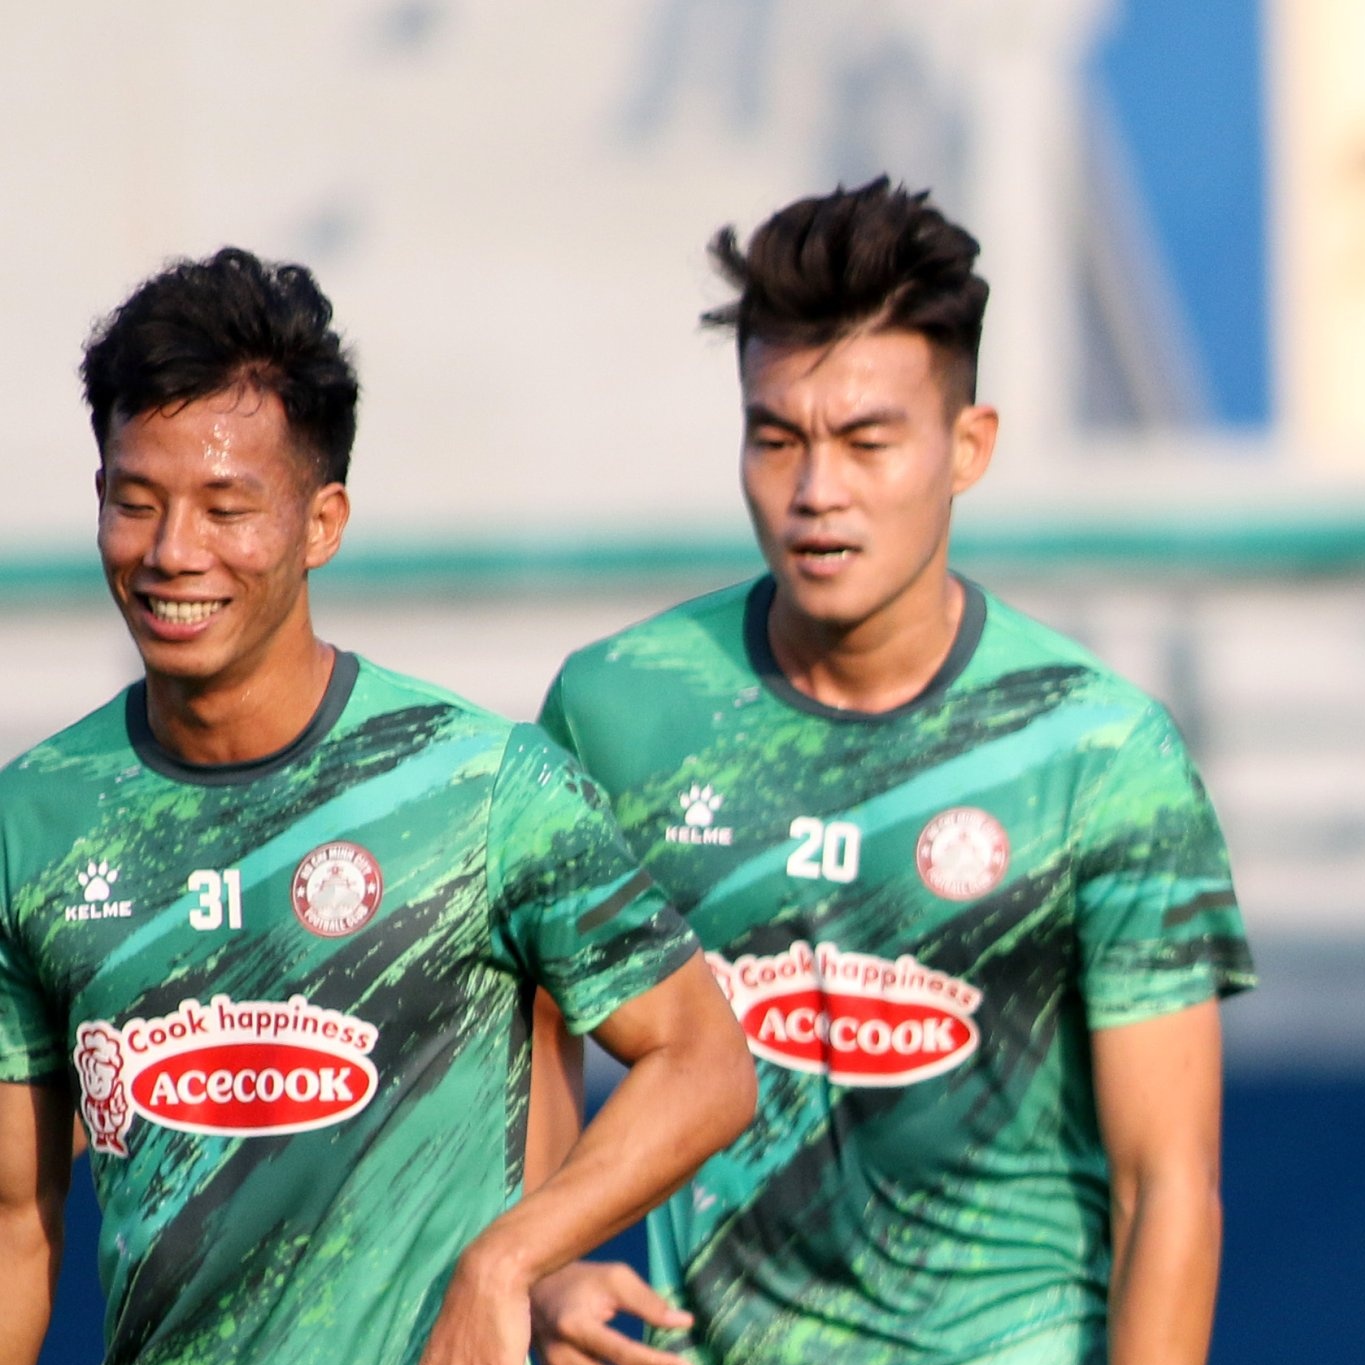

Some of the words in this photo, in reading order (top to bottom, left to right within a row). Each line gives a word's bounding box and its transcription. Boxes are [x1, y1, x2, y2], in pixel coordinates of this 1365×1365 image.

[666, 826, 734, 846] KELME
[786, 816, 860, 883] 20
[65, 901, 132, 922] KELME
[188, 868, 242, 931] 31
[740, 951, 813, 989] Cook
[821, 952, 974, 1005] happiness
[128, 1010, 207, 1053] Cook
[219, 1005, 370, 1049] happiness
